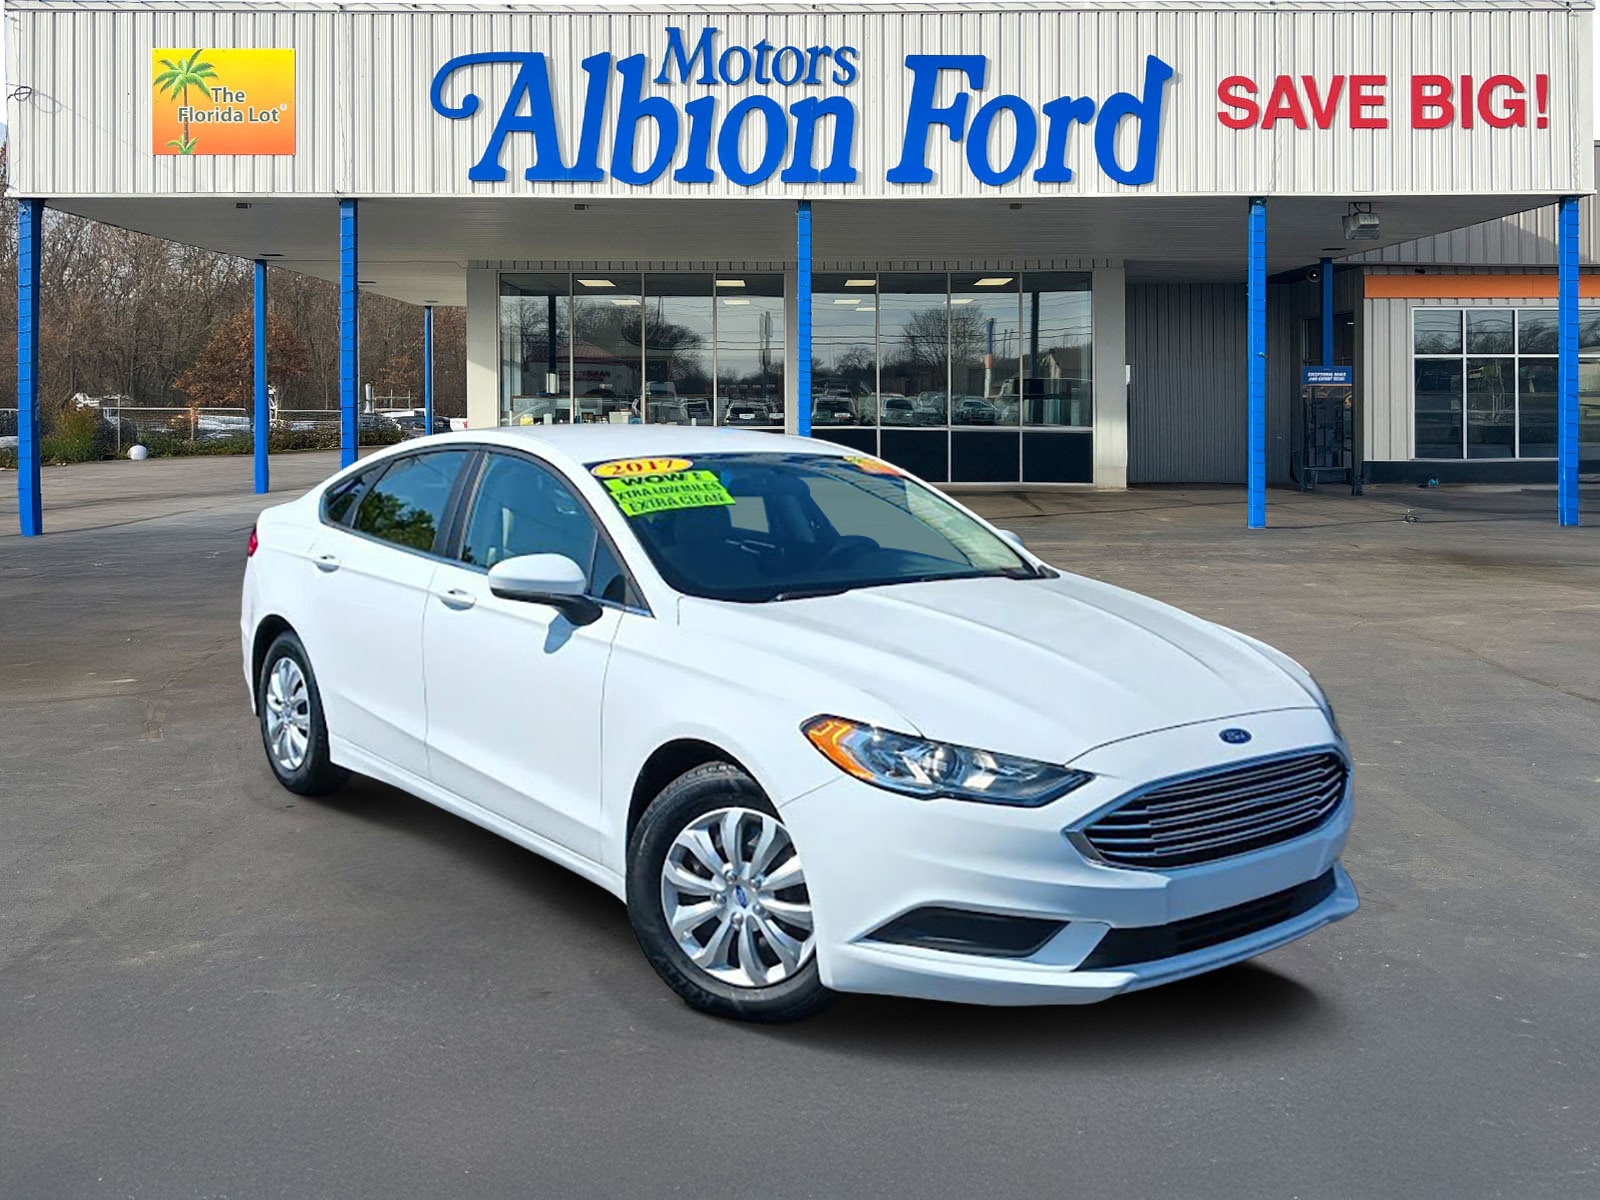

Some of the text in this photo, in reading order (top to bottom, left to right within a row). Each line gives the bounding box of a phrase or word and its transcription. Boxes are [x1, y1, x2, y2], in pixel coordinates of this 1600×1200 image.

[653, 27, 857, 86] Motors
[210, 86, 246, 104] The
[1217, 74, 1549, 130] SAVE BIG!
[178, 106, 280, 123] Florida Lot
[430, 52, 1175, 187] Albion Ford
[612, 460, 673, 475] 2017
[621, 473, 685, 486] WOW
[628, 498, 679, 513] EXTRA
